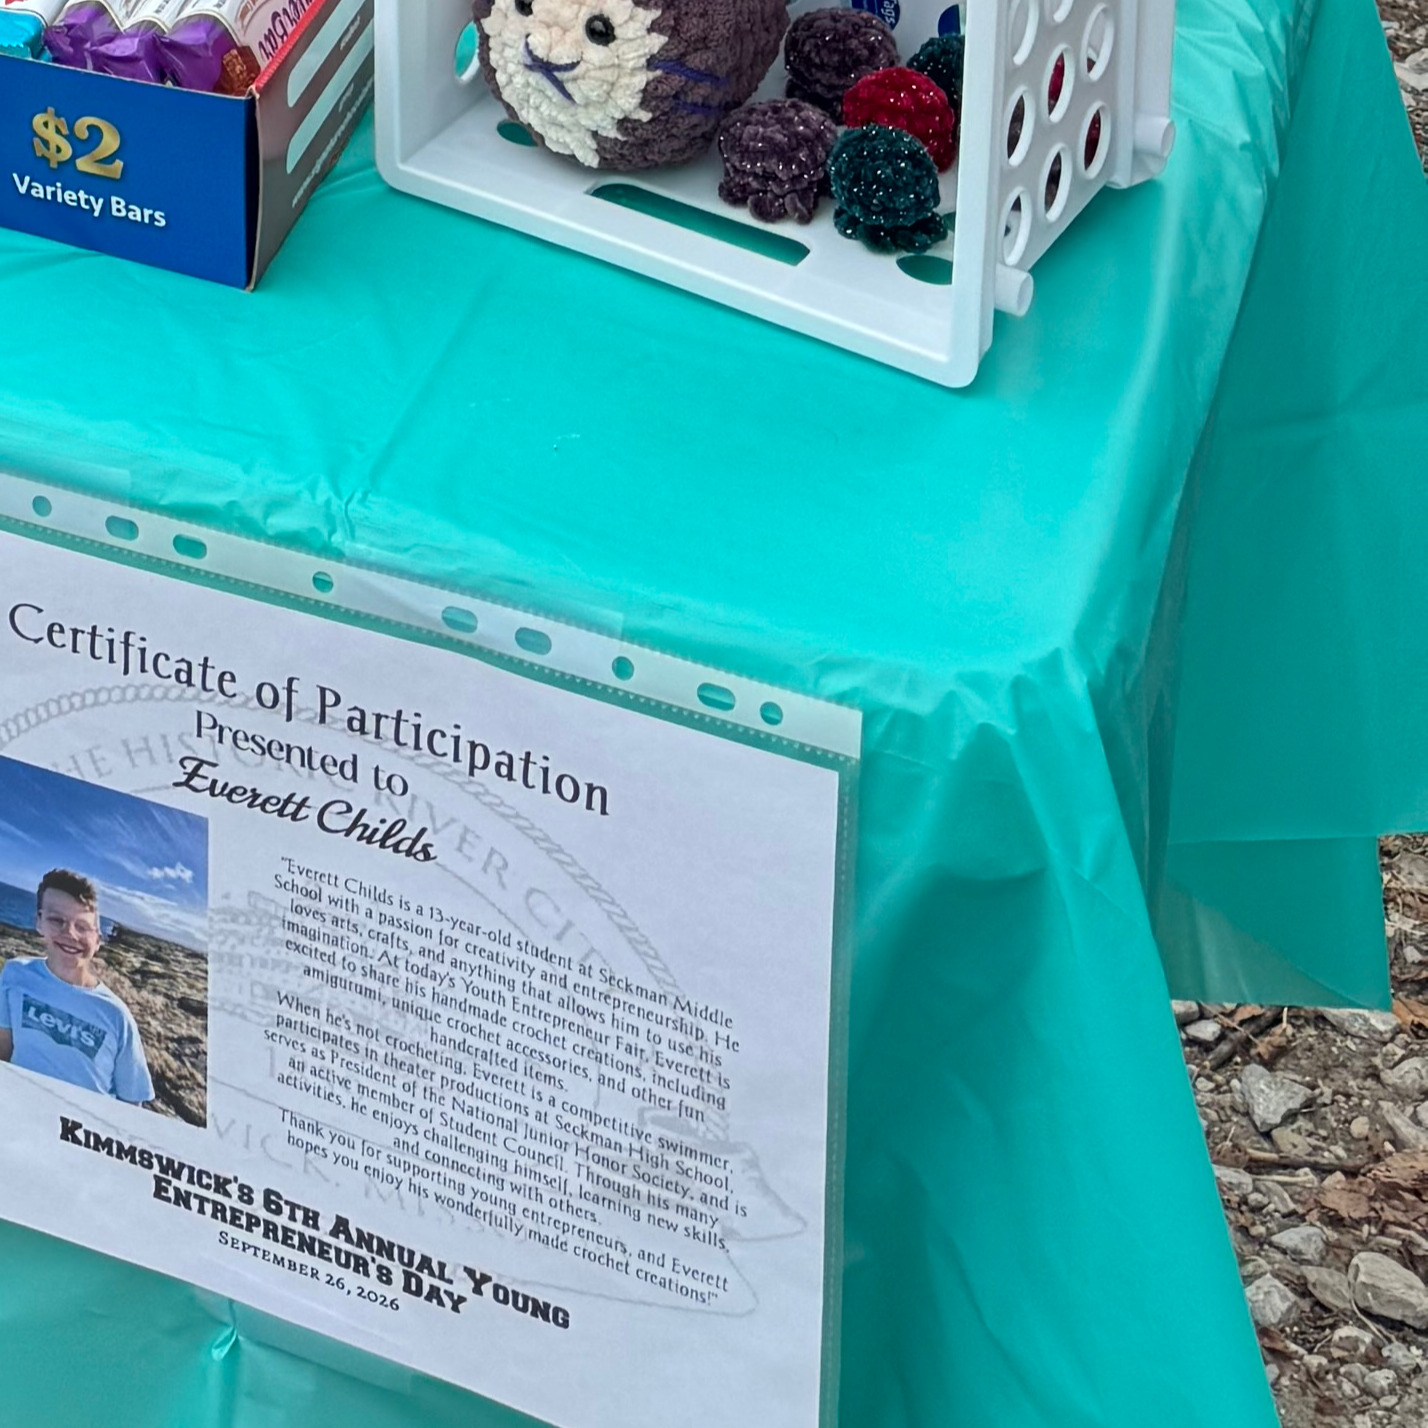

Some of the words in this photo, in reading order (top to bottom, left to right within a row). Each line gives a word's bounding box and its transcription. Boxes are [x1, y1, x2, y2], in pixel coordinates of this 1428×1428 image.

[12, 172, 105, 217] Variety
[111, 195, 167, 228] Bars
[32, 106, 124, 181] $2
[9, 603, 237, 698] Certificate
[255, 677, 299, 723] of
[317, 685, 611, 816] Participation
[195, 710, 359, 784] Presented
[373, 764, 410, 797] to
[172, 755, 311, 822] Everett
[316, 799, 438, 863] Childs
[274, 873, 322, 903] School
[327, 894, 360, 915] with
[364, 907, 373, 920] a
[378, 911, 433, 940] passion
[438, 928, 460, 949] for
[464, 942, 536, 979] creativity
[540, 970, 568, 990] and
[572, 982, 708, 1042] entrepreneurship.
[715, 1030, 740, 1053] He
[290, 897, 327, 924] loves
[331, 915, 363, 938] arts,
[367, 928, 413, 956] crafts,
[418, 946, 445, 965] and
[450, 957, 516, 993] anything
[522, 980, 552, 1004] that
[557, 995, 606, 1025] allows
[611, 1012, 640, 1038] him
[646, 1028, 662, 1046] to
[667, 1038, 694, 1057] use
[699, 1045, 722, 1067] his
[344, 878, 394, 906] Childs
[399, 895, 411, 912] is
[415, 904, 424, 917] a
[429, 906, 512, 948] 13-year-old
[516, 940, 573, 971] student
[578, 963, 593, 979] at
[599, 967, 668, 1006] Seckman
[672, 995, 733, 1029] Middle
[377, 949, 400, 970] At
[404, 957, 456, 989] today's
[460, 976, 506, 1008] Youth
[512, 995, 611, 1046] Entrepreneur
[615, 1034, 649, 1063] Fair,
[655, 1050, 712, 1084] Everett
[718, 1071, 731, 1090] is
[285, 939, 337, 967] excited
[341, 955, 357, 974] to
[360, 963, 400, 988] share
[405, 976, 427, 998] his
[431, 986, 507, 1028] handmade
[512, 1020, 567, 1051] crochet
[572, 1043, 646, 1082] creations,
[652, 1069, 726, 1111] including
[303, 965, 386, 1007] amigurumi,
[391, 996, 442, 1024] unique
[446, 1017, 501, 1047] crochet
[506, 1038, 592, 1082] accessories,
[597, 1073, 626, 1094] and
[631, 1086, 673, 1111] other
[678, 1099, 705, 1123] fun
[430, 1025, 518, 1073] handcrafted
[523, 1060, 567, 1090] items.
[59, 1115, 255, 1208] KIMMSWICK'S
[262, 1188, 321, 1232] 6TH
[329, 1216, 454, 1286] ANNUAL
[463, 1265, 571, 1331] YOUNG
[153, 1173, 394, 1288] ENTREPRENEUR'S
[401, 1268, 467, 1315] DAY
[219, 1230, 321, 1282] SEPTEMBER
[325, 1271, 352, 1297] 26,
[357, 1285, 401, 1313] 2026
